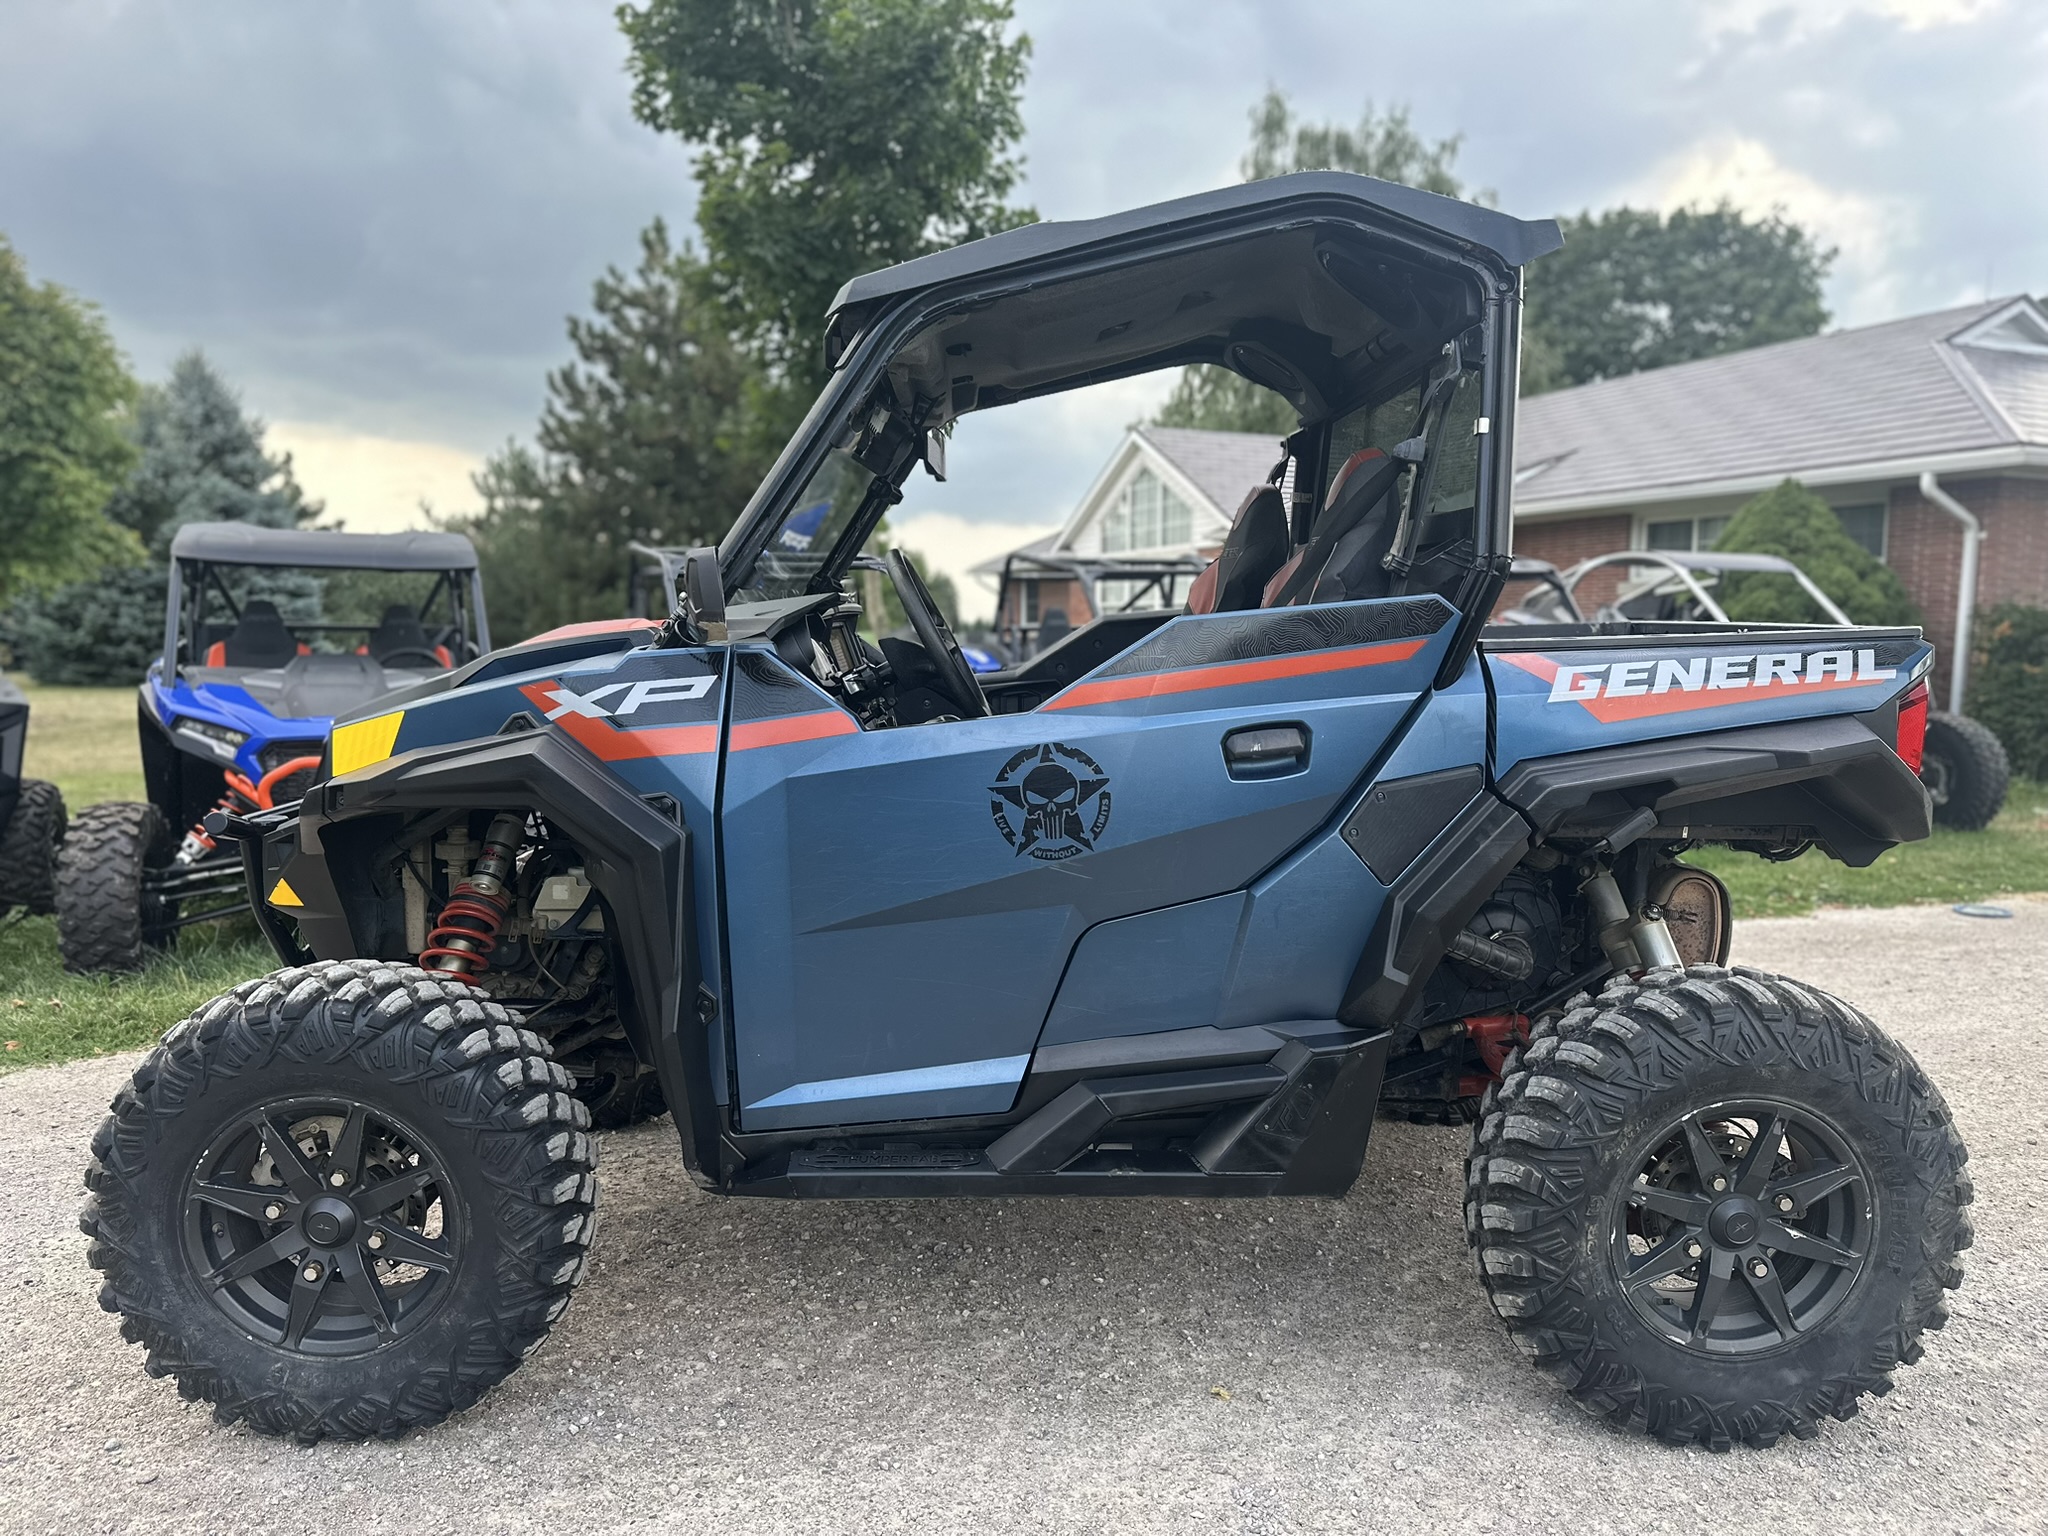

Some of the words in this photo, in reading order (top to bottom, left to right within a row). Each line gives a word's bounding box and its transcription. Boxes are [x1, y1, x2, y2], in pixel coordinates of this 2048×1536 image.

[542, 675, 718, 721] XP
[1547, 649, 1897, 703] GENERAL
[993, 811, 1011, 835] LIVE
[1034, 847, 1077, 859] WITHOUT
[1093, 798, 1109, 833] LIMITS
[840, 1154, 908, 1164] THUMPER
[911, 1154, 940, 1164] FAB
